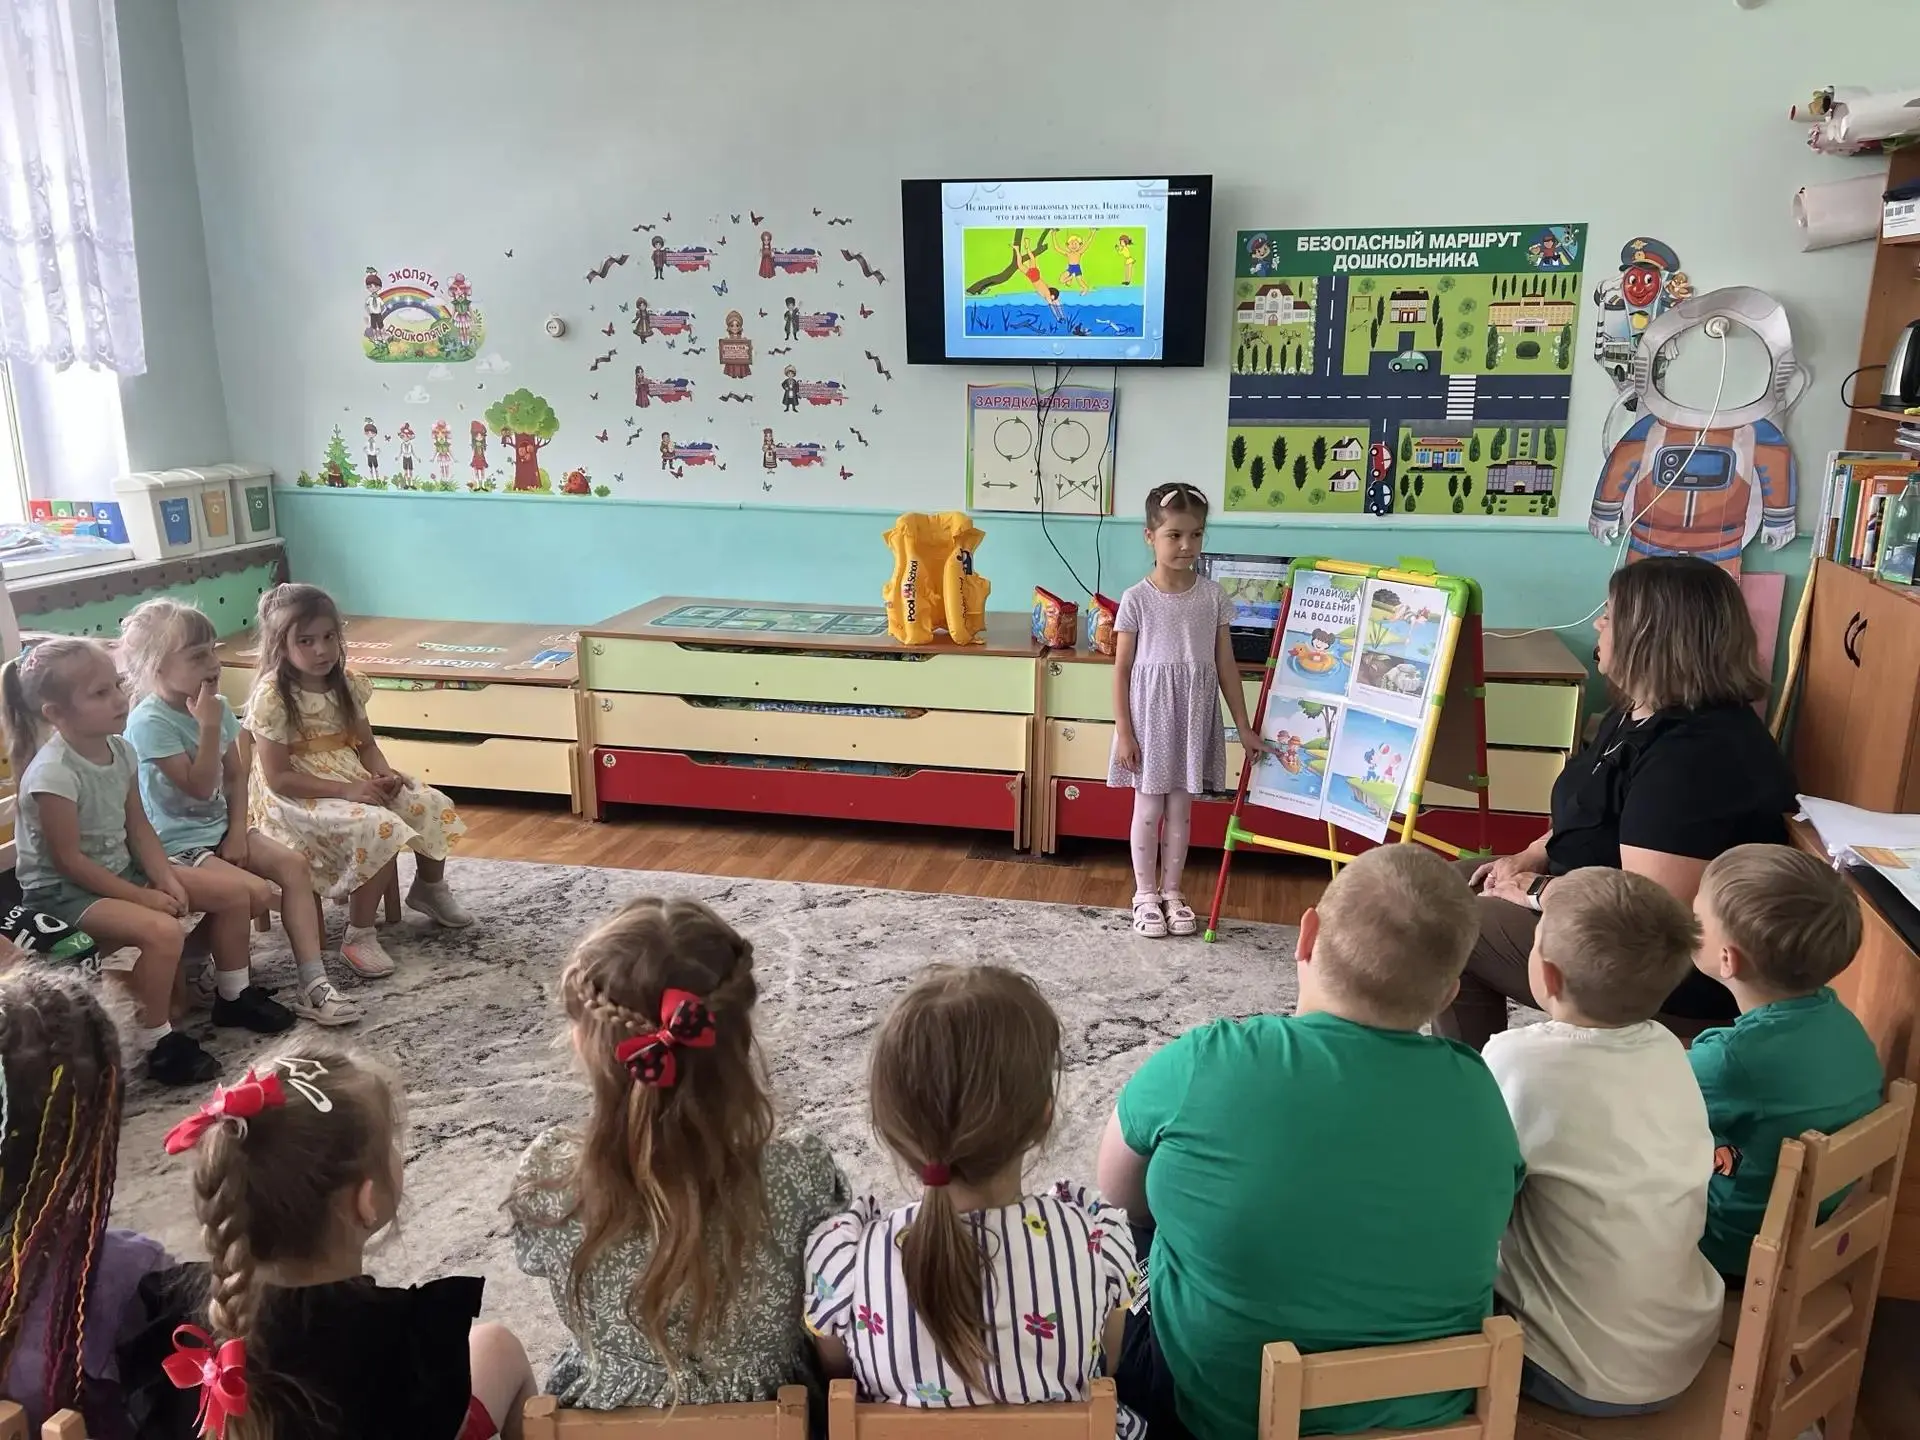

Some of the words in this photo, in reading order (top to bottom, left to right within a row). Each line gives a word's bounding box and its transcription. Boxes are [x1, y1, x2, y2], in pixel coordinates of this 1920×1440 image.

[1297, 231, 1425, 251] БЕЗОПАСНЫЙ
[1429, 232, 1522, 249] МАРШРУТ
[1333, 252, 1479, 272] ДОШКОЛЬНИКА
[388, 268, 439, 291] ЭКОЛЯТА
[386, 322, 449, 343] ДОШКОЛЯТА
[975, 395, 1038, 409] ЗАРЯДКА
[1075, 398, 1110, 410] ГЛАЗ
[908, 560, 918, 582] School
[1306, 586, 1351, 599] ПРАВИЛА
[907, 599, 916, 622] Pool
[1299, 598, 1356, 612] ПОВЕДЕНИЯ
[1293, 609, 1307, 620] НА
[1311, 611, 1356, 626] ВОДОЕМЕ
